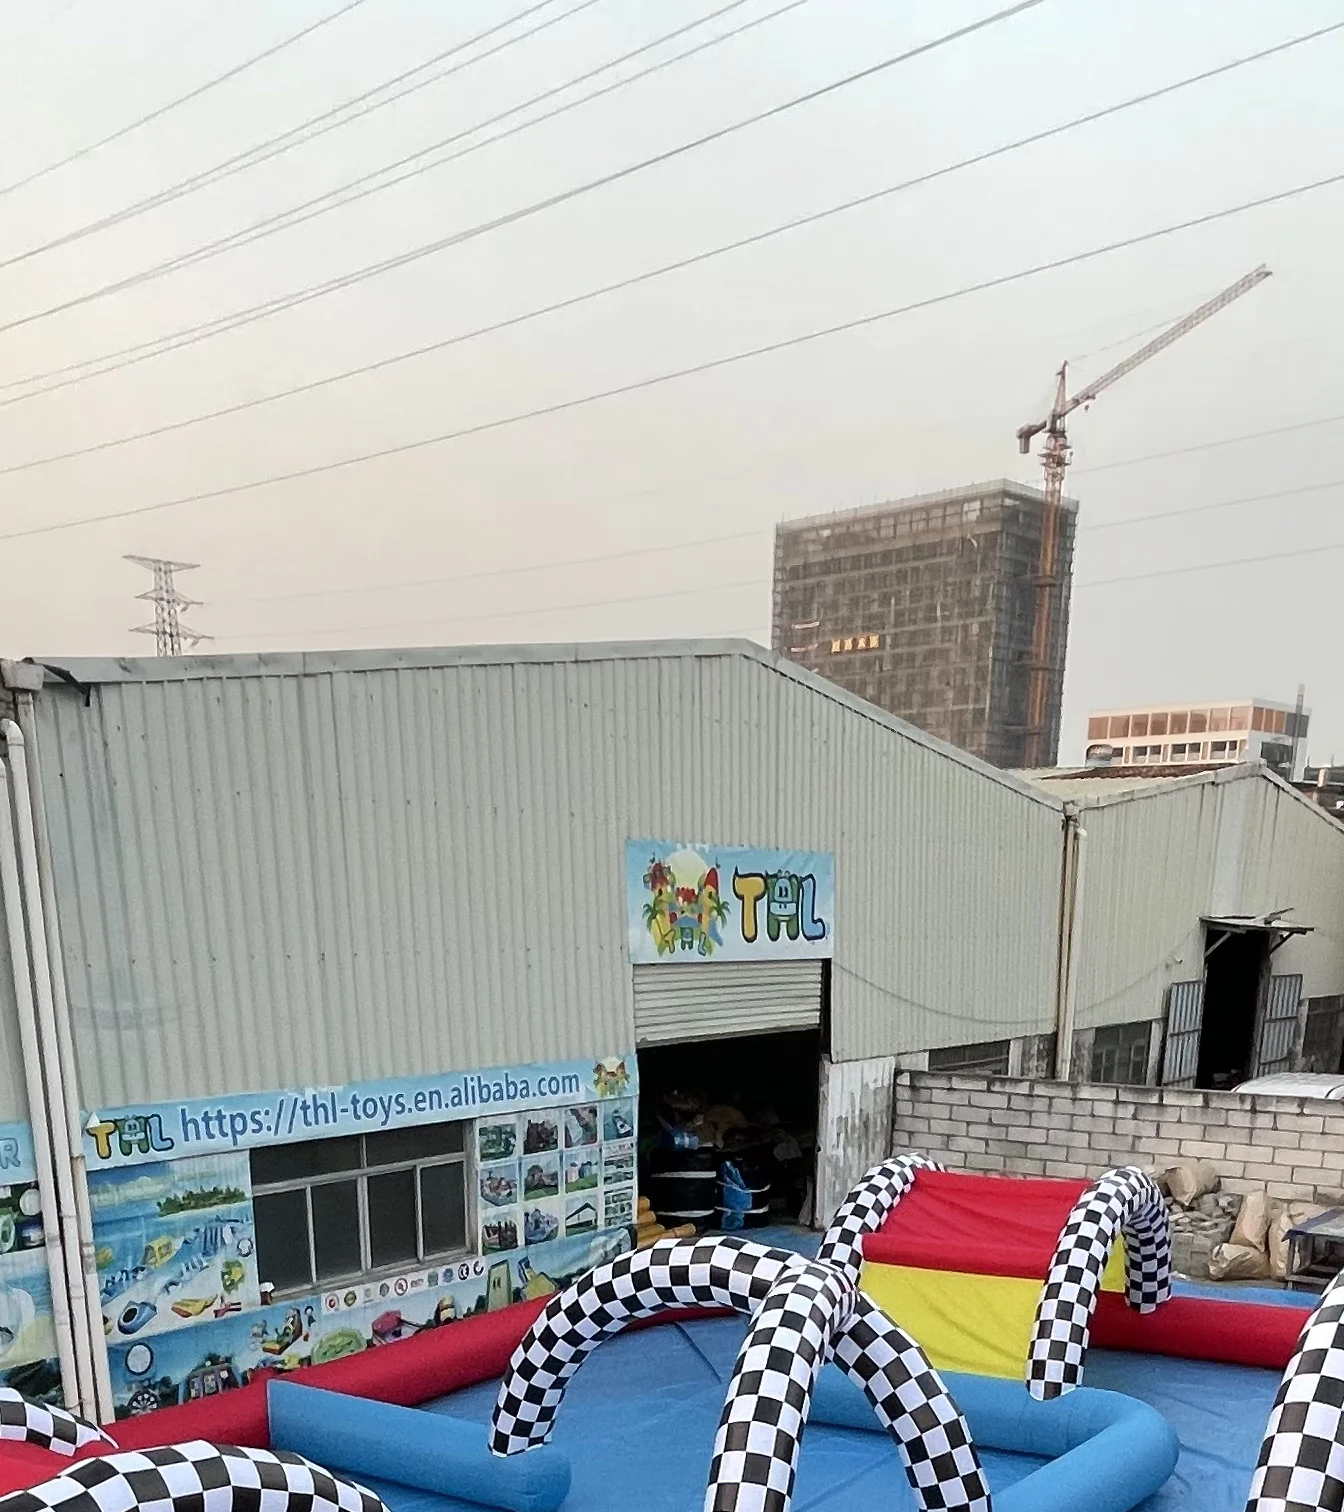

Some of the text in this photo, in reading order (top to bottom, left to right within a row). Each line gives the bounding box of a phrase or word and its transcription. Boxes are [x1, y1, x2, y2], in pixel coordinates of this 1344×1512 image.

[733, 866, 826, 943] THL
[85, 1071, 580, 1160] THL https://thl-toys.en.alibaba.com
